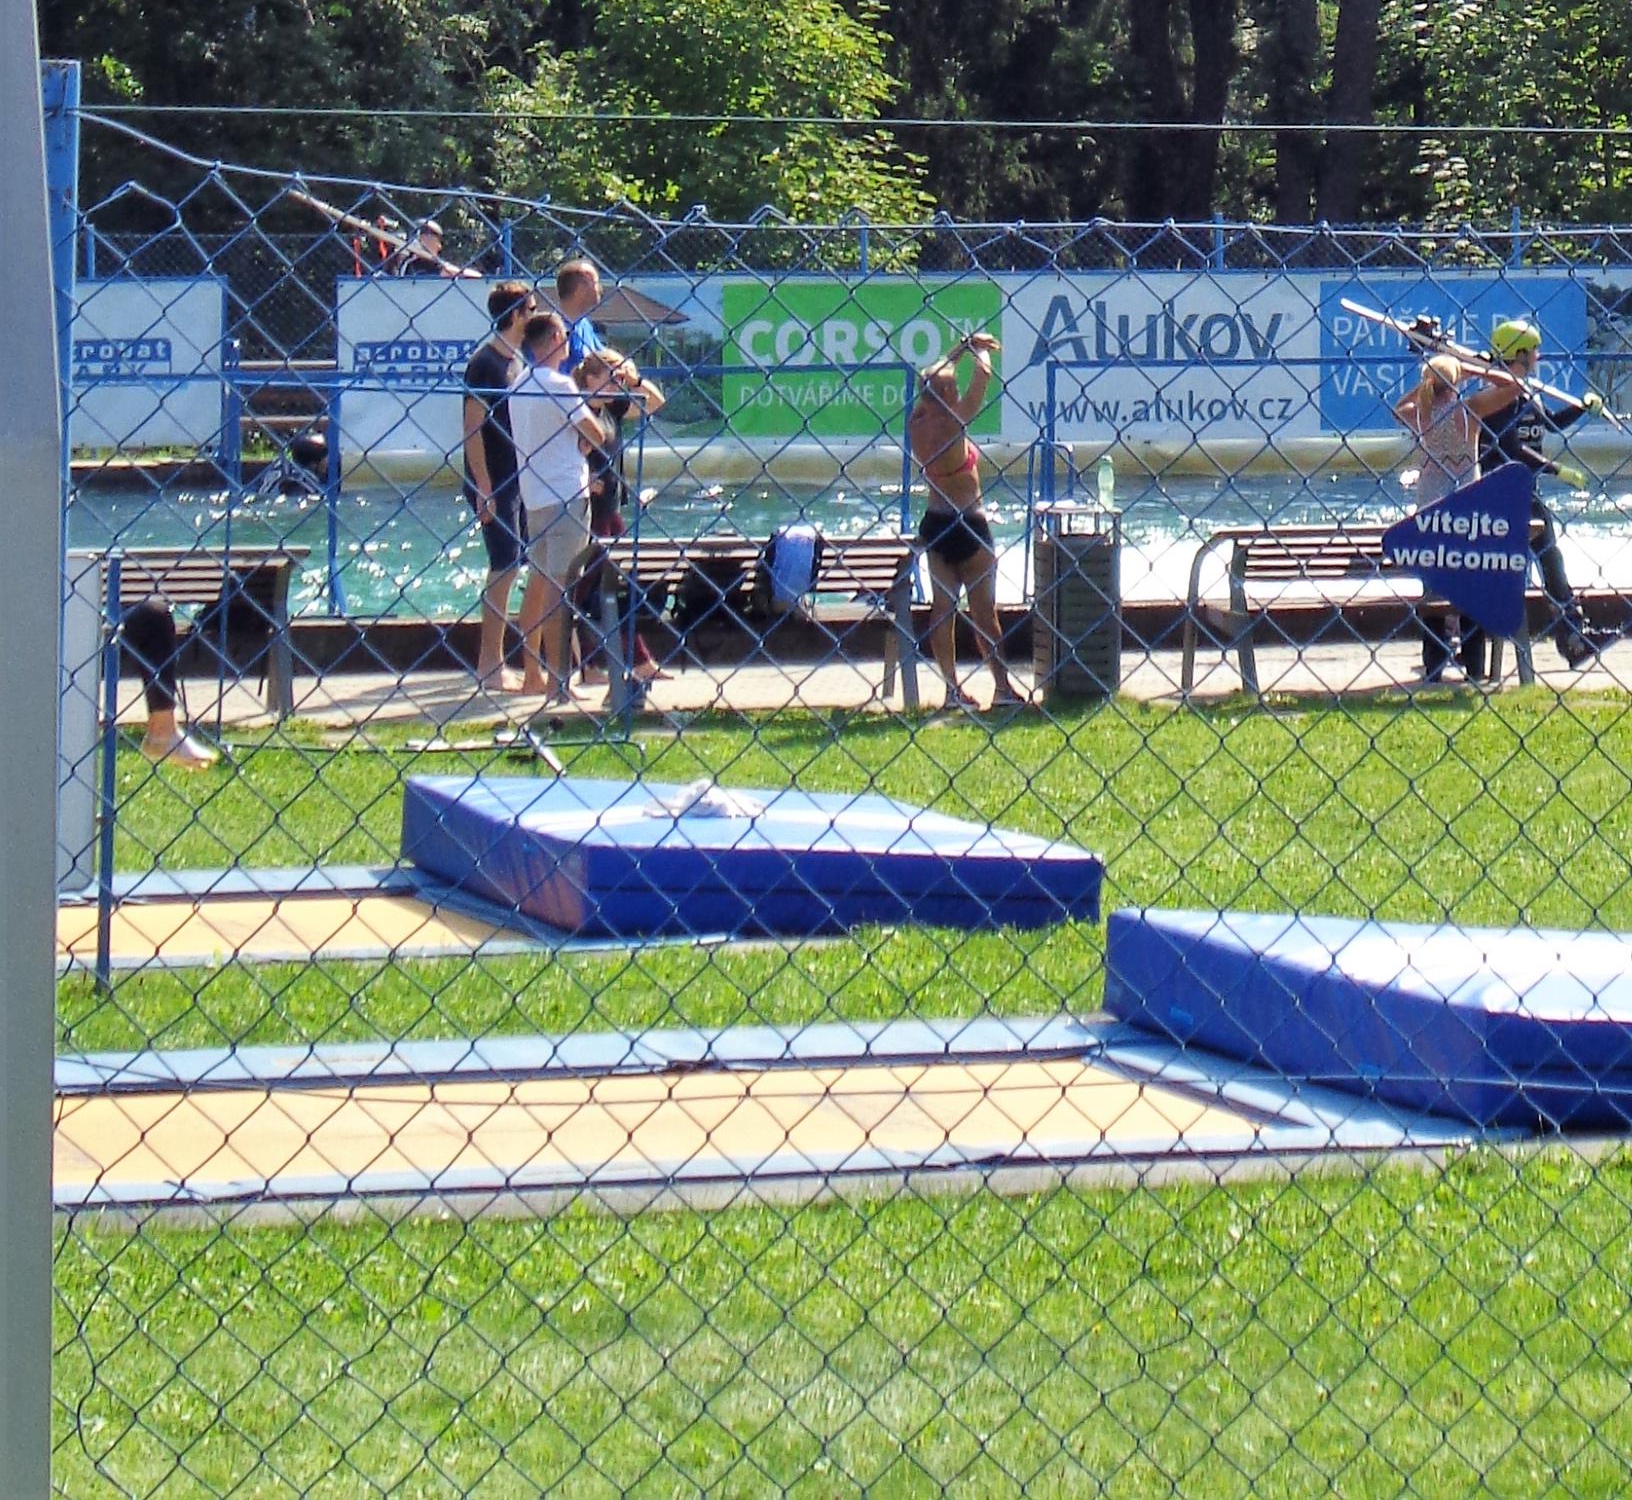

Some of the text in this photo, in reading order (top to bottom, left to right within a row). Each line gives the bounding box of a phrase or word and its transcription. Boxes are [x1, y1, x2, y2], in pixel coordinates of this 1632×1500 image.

[739, 319, 942, 368] CORSO
[1028, 294, 1284, 367] Alukov
[73, 341, 167, 359] robat
[1028, 390, 1294, 423] www.alukov.cz
[1415, 509, 1510, 541] vítejte
[1393, 544, 1527, 572] welcome
